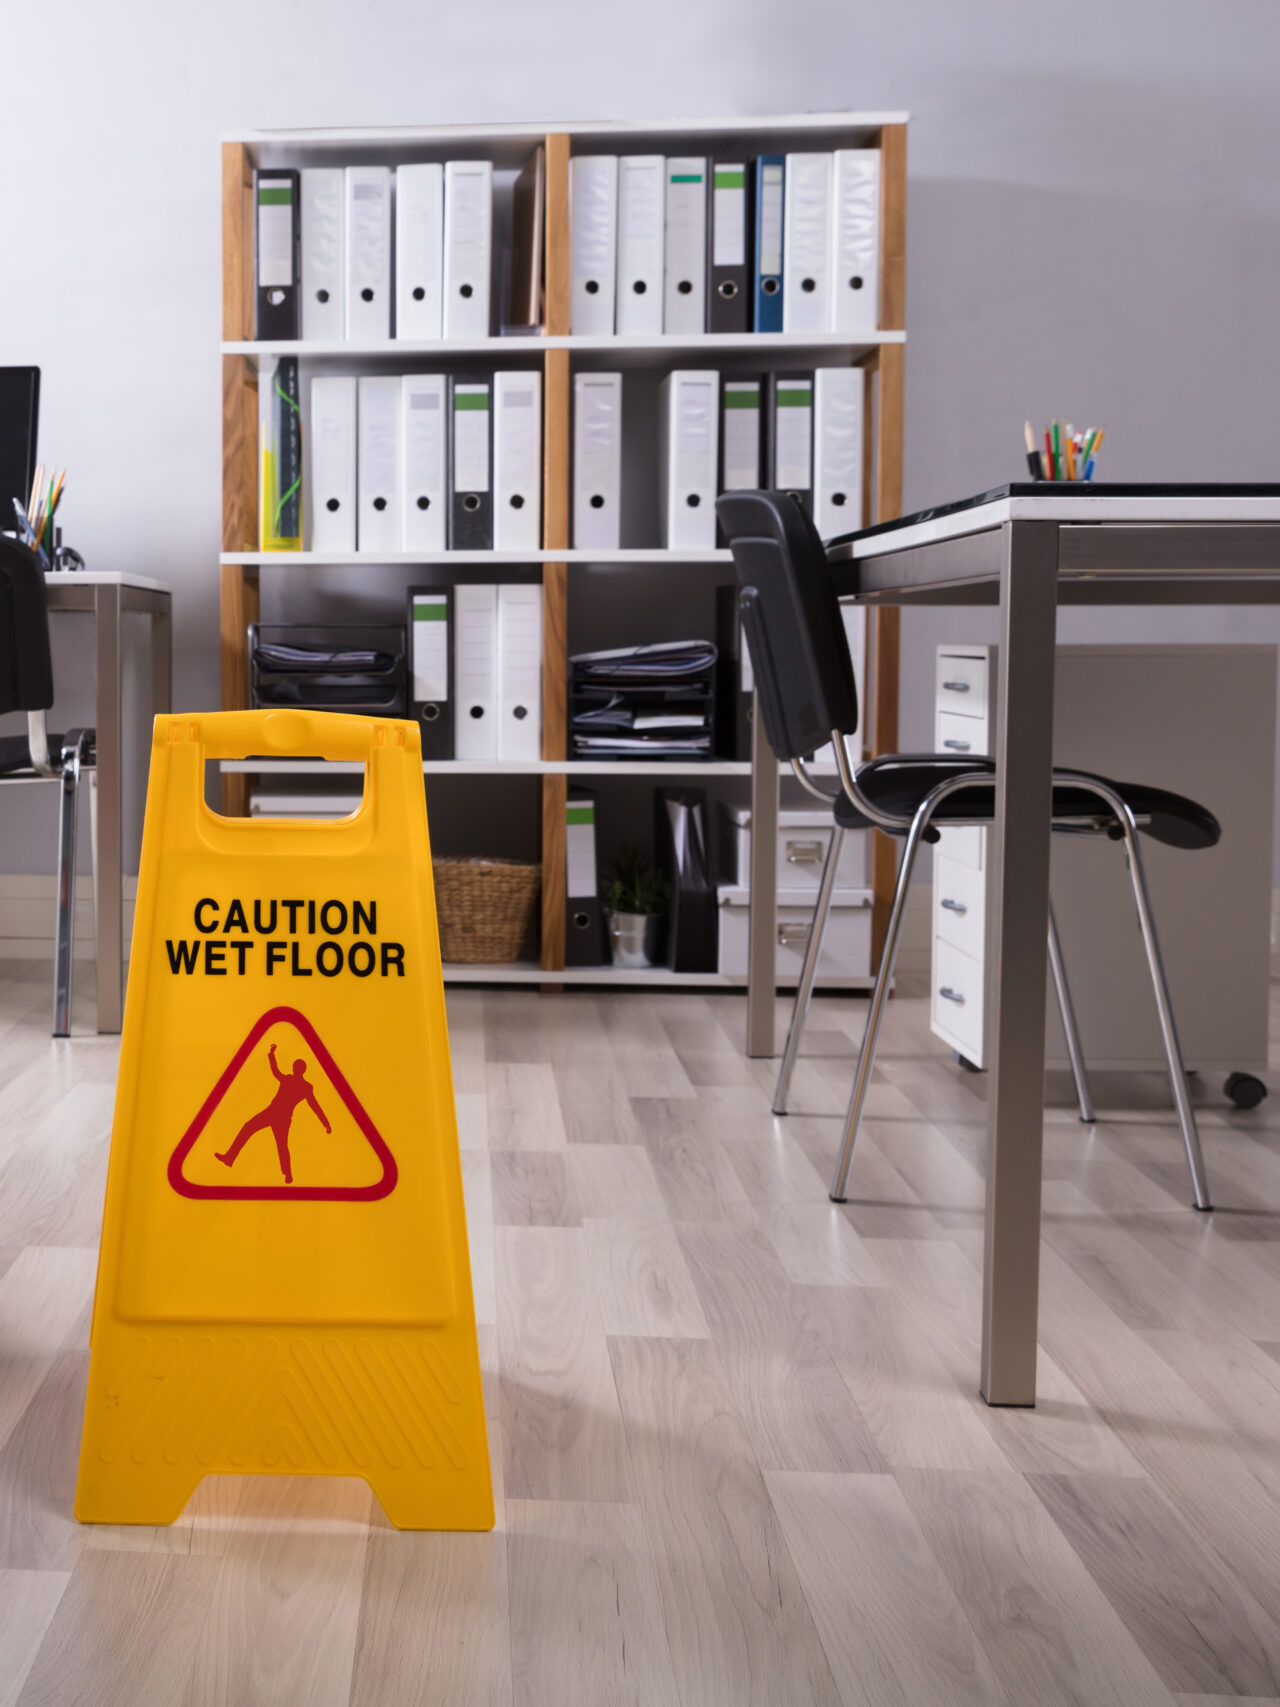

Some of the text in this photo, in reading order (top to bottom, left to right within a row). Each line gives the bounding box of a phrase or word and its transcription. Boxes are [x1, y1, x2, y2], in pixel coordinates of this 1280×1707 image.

[194, 898, 377, 935] CAUTION
[166, 940, 406, 977] WET FLOOR
